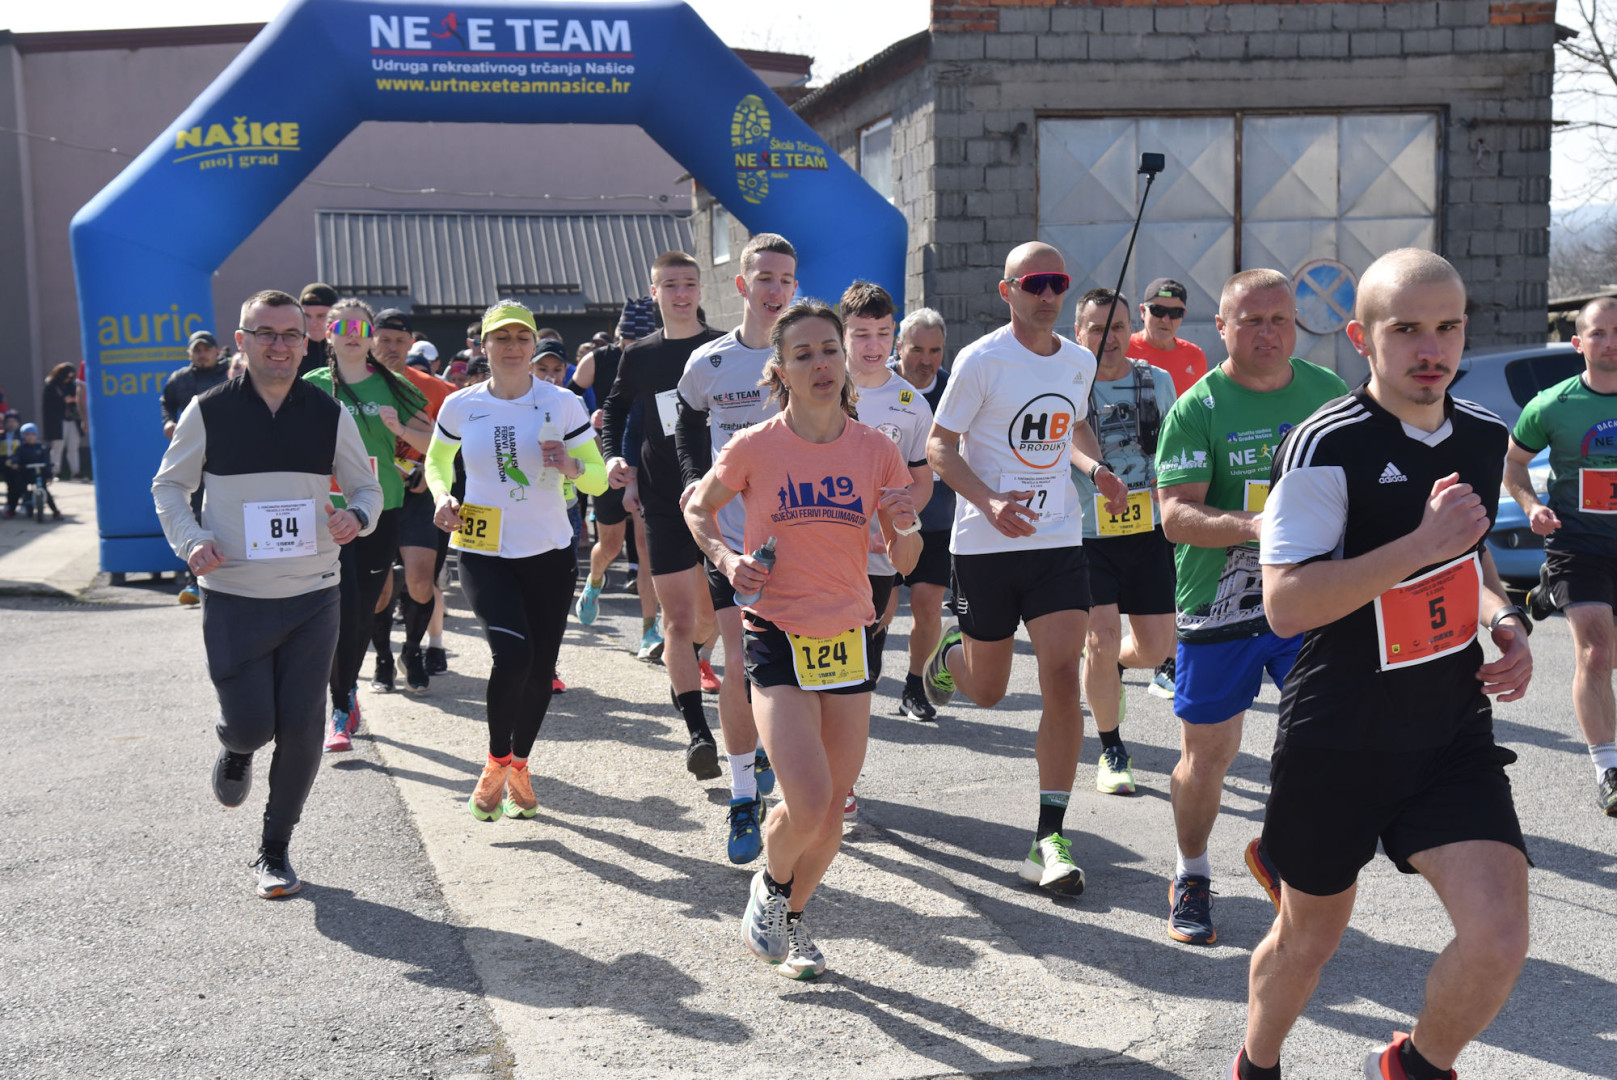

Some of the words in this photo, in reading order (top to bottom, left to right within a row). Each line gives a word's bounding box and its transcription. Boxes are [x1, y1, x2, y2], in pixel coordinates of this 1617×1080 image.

[505, 19, 632, 52] TEAM
[372, 59, 428, 74] Udruga
[432, 62, 528, 76] rekreativnog
[531, 62, 582, 76] trčanja
[586, 62, 635, 74] Našice
[376, 78, 631, 94] www.urtnexeteamnasice.hr
[175, 116, 299, 149] NAŠICE
[200, 154, 233, 170] moj
[239, 153, 278, 168] grad
[785, 153, 828, 168] TEAM
[98, 304, 202, 346] auric
[736, 390, 760, 399] TEAM
[1021, 413, 1070, 440] HB
[494, 426, 507, 482] POLUMARATON
[820, 476, 856, 498] 19.
[1379, 474, 1408, 484] adidas
[771, 509, 798, 522] OSJEČKI
[800, 508, 820, 518] FERIVI
[270, 518, 298, 538] 84
[1429, 596, 1447, 630] 5
[802, 642, 848, 670] 124
